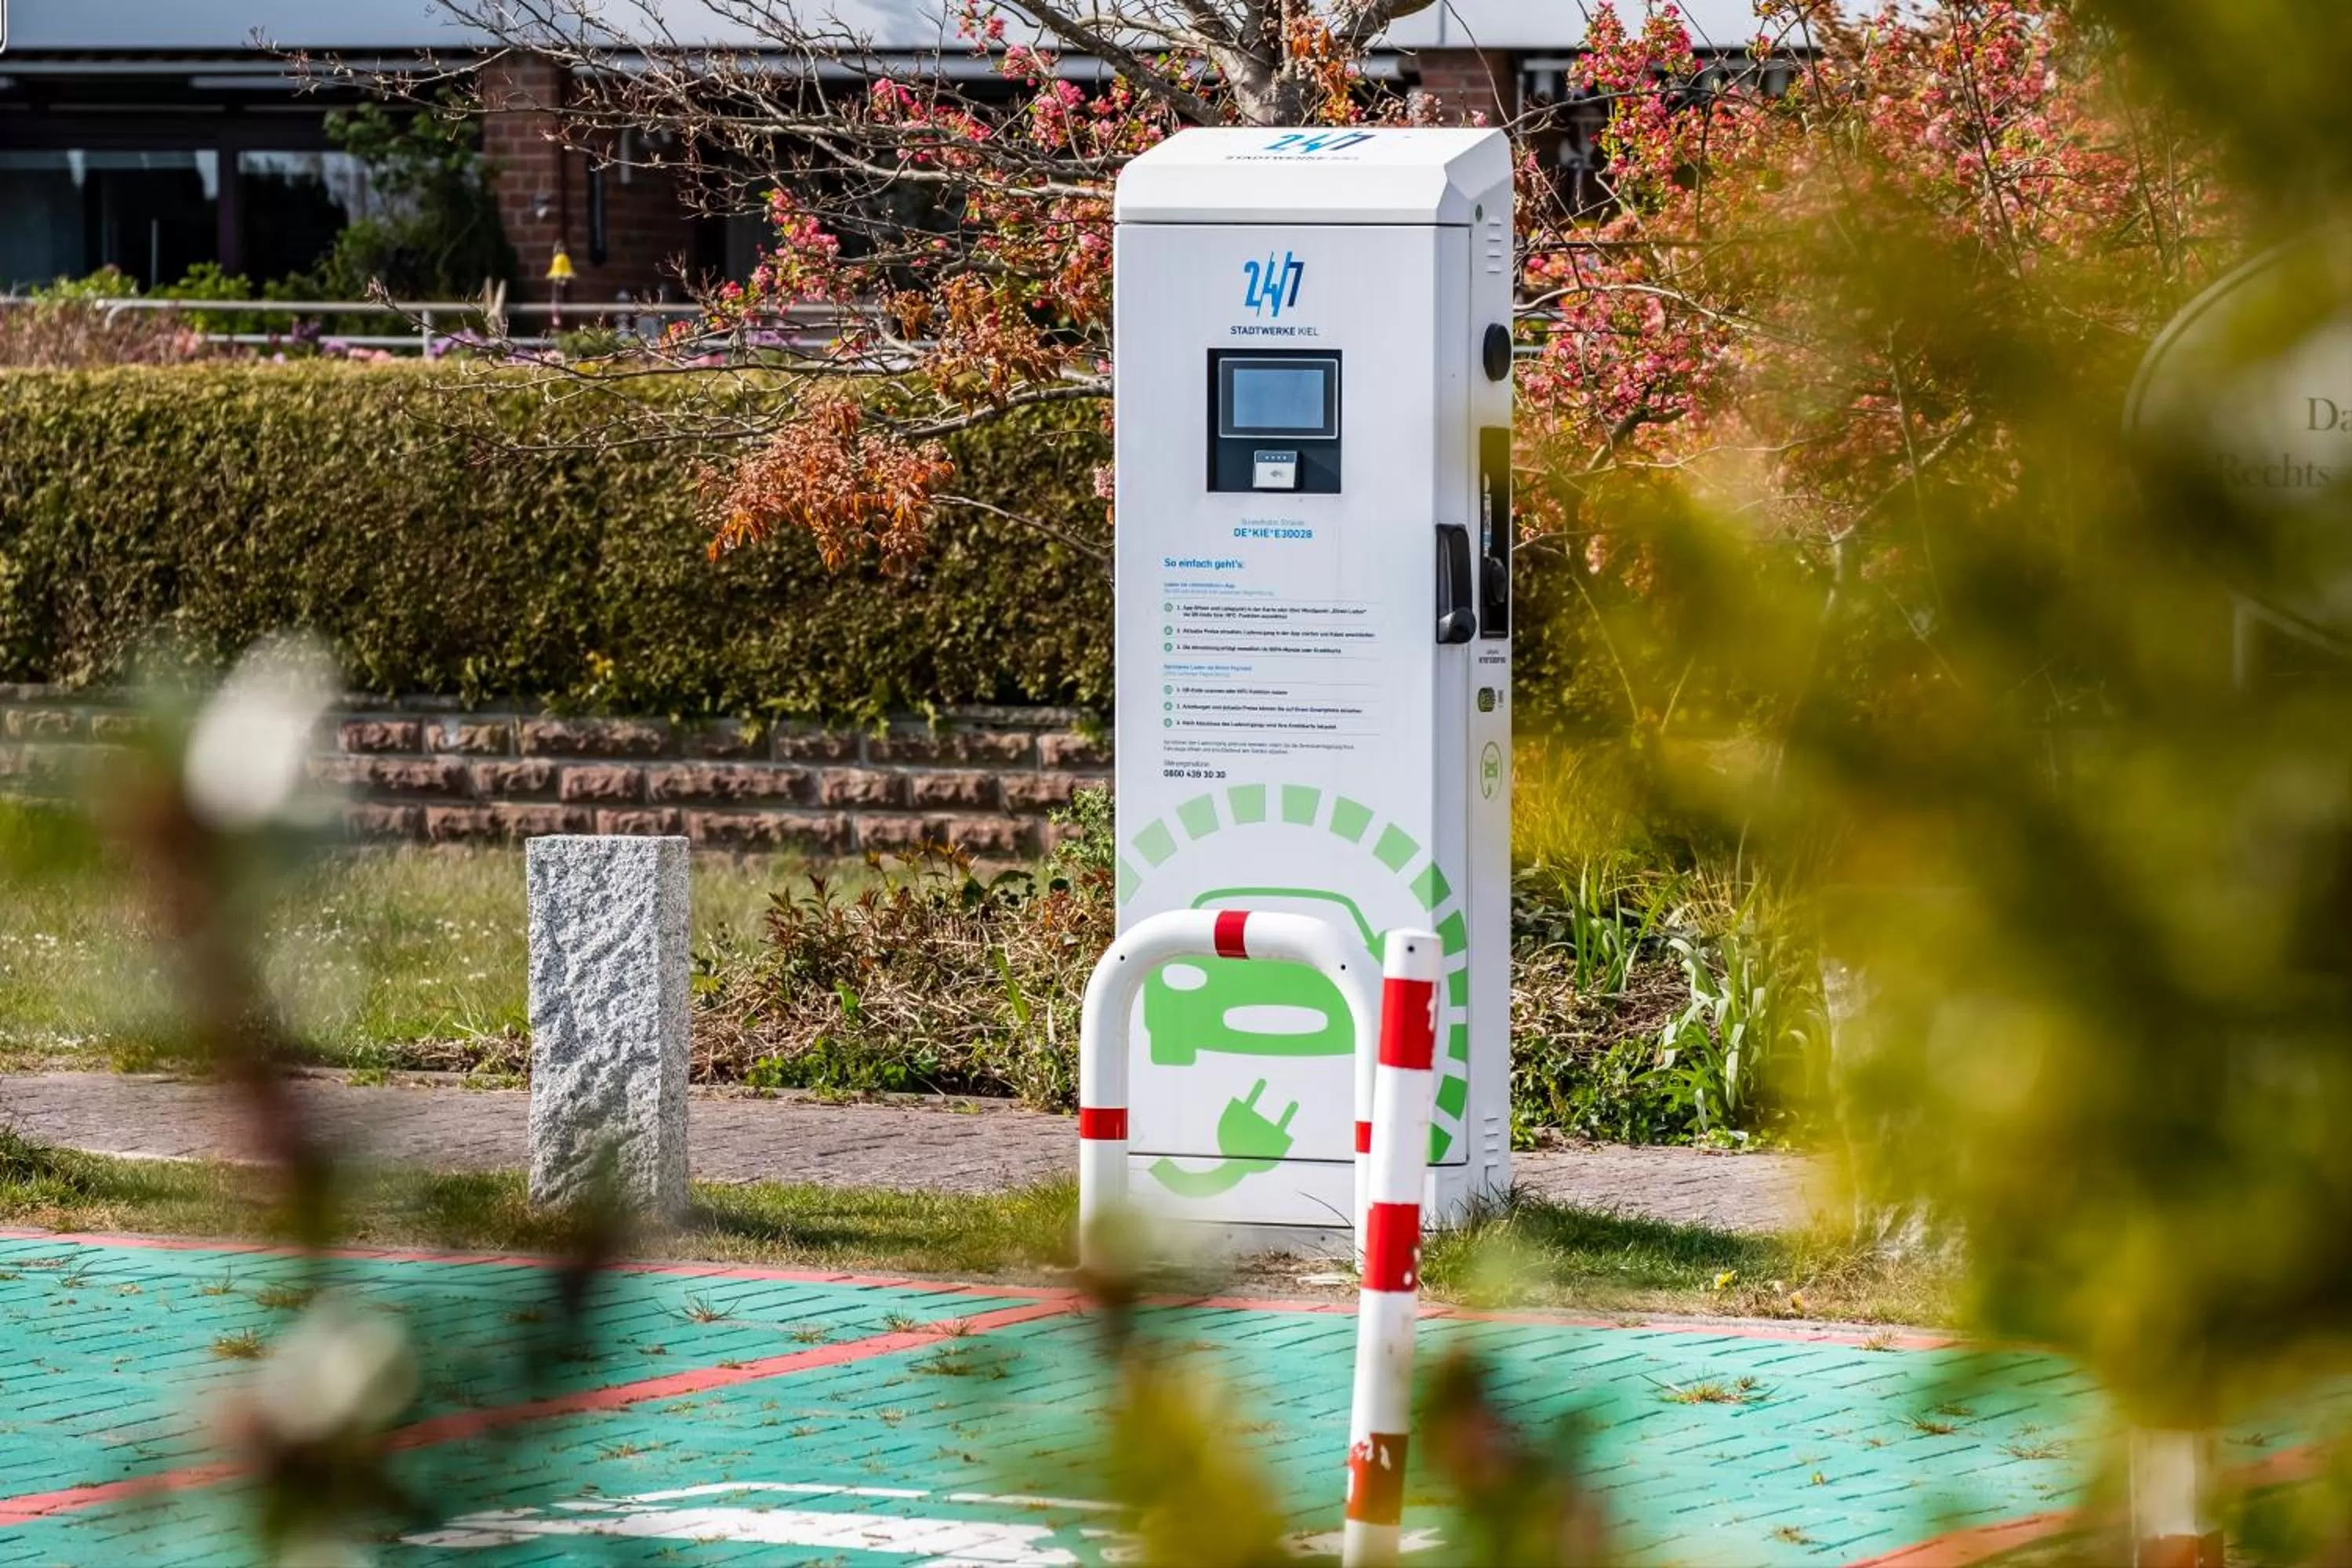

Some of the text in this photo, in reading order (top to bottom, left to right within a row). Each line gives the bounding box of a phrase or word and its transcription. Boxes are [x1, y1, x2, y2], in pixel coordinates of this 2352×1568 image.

[1229, 325, 1319, 336] STADTWERKE KIEL
[1164, 557, 1177, 567] So
[1178, 558, 1214, 568] einfach
[1163, 769, 1185, 778] 0800
[1186, 770, 1202, 779] 439
